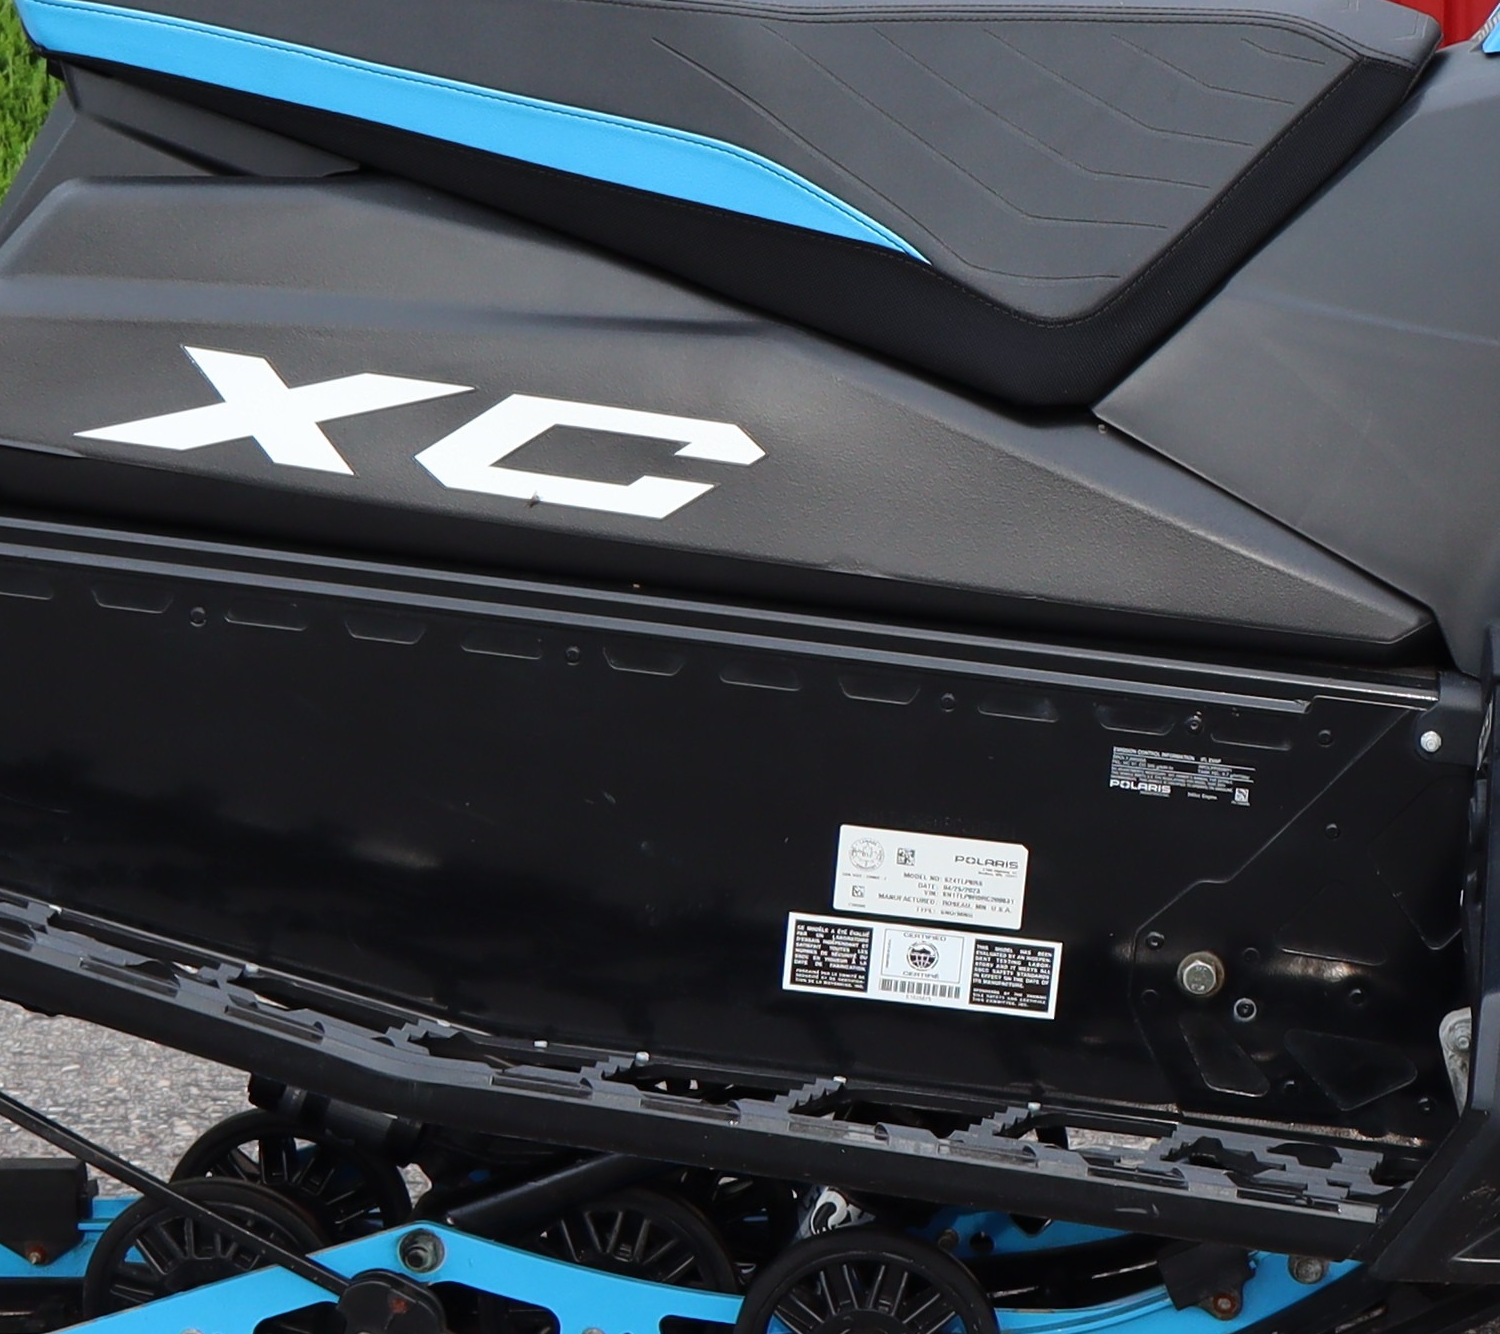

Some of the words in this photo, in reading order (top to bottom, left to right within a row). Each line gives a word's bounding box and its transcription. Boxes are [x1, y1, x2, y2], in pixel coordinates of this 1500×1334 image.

[73, 344, 767, 520] XC
[1110, 779, 1171, 794] POLARIS
[954, 855, 1019, 869] POLARIS
